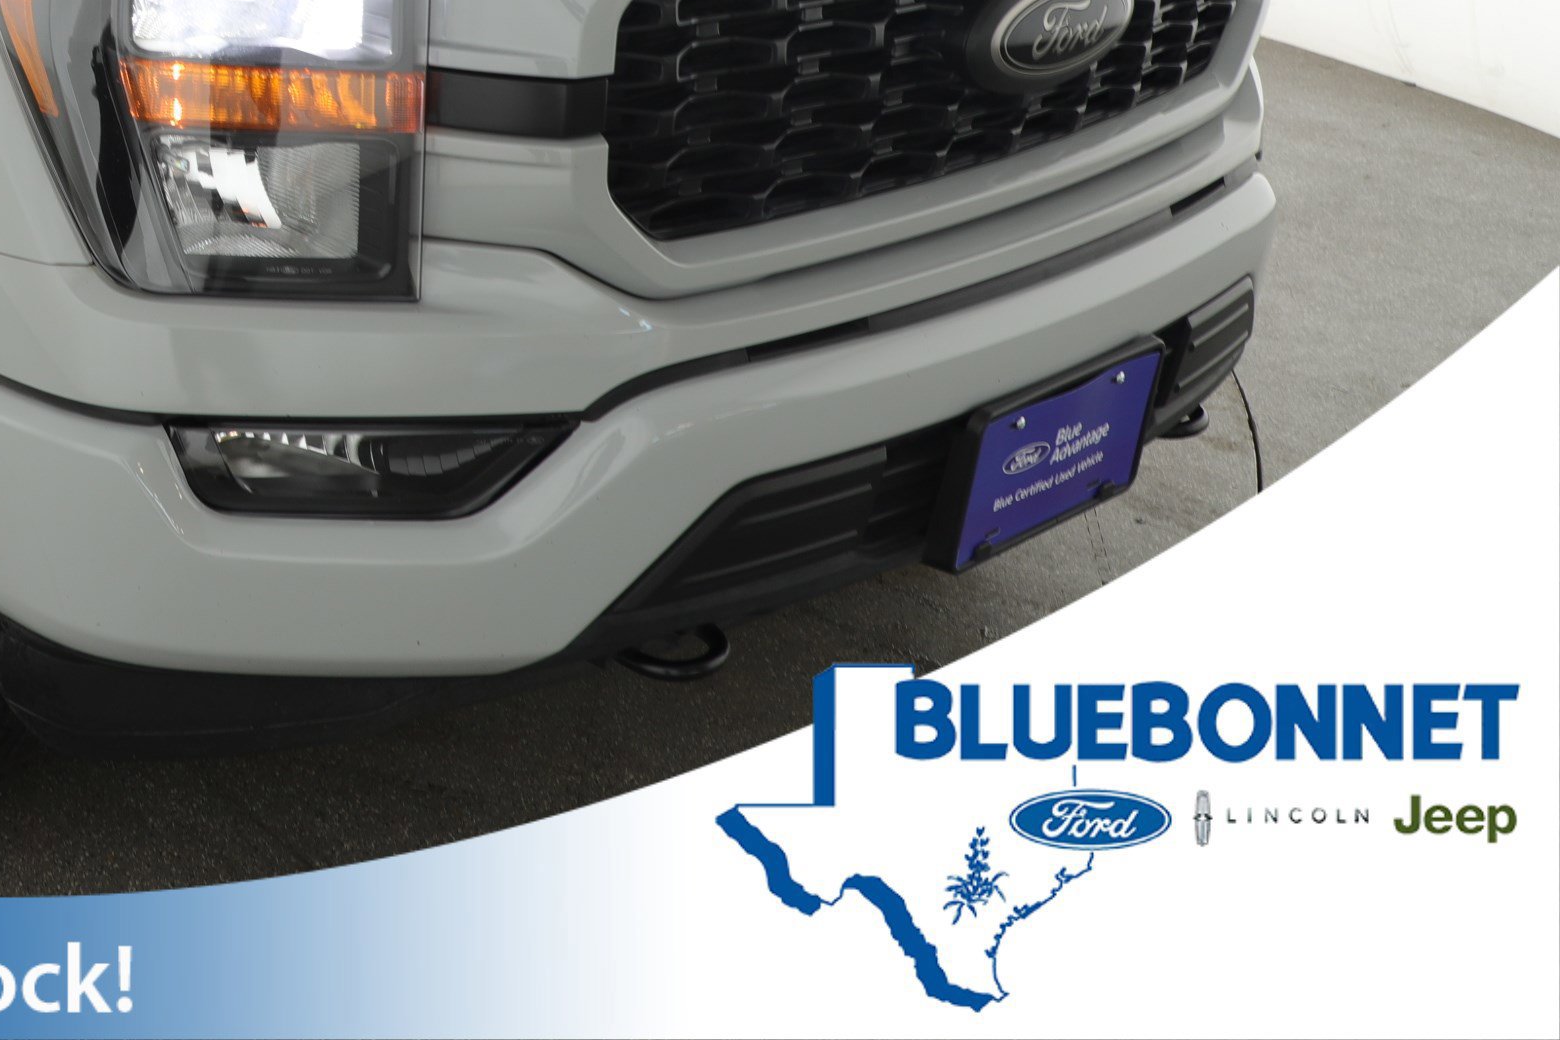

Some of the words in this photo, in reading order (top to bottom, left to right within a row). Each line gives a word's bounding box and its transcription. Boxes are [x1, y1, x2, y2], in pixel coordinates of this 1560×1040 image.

[1049, 423, 1110, 465] Advantage
[1056, 422, 1082, 446] Blue
[1011, 447, 1042, 471] Ford
[993, 494, 1014, 512] Blue
[1015, 476, 1054, 501] Certified
[1055, 464, 1076, 485] Used
[1077, 450, 1104, 473] Vehicle
